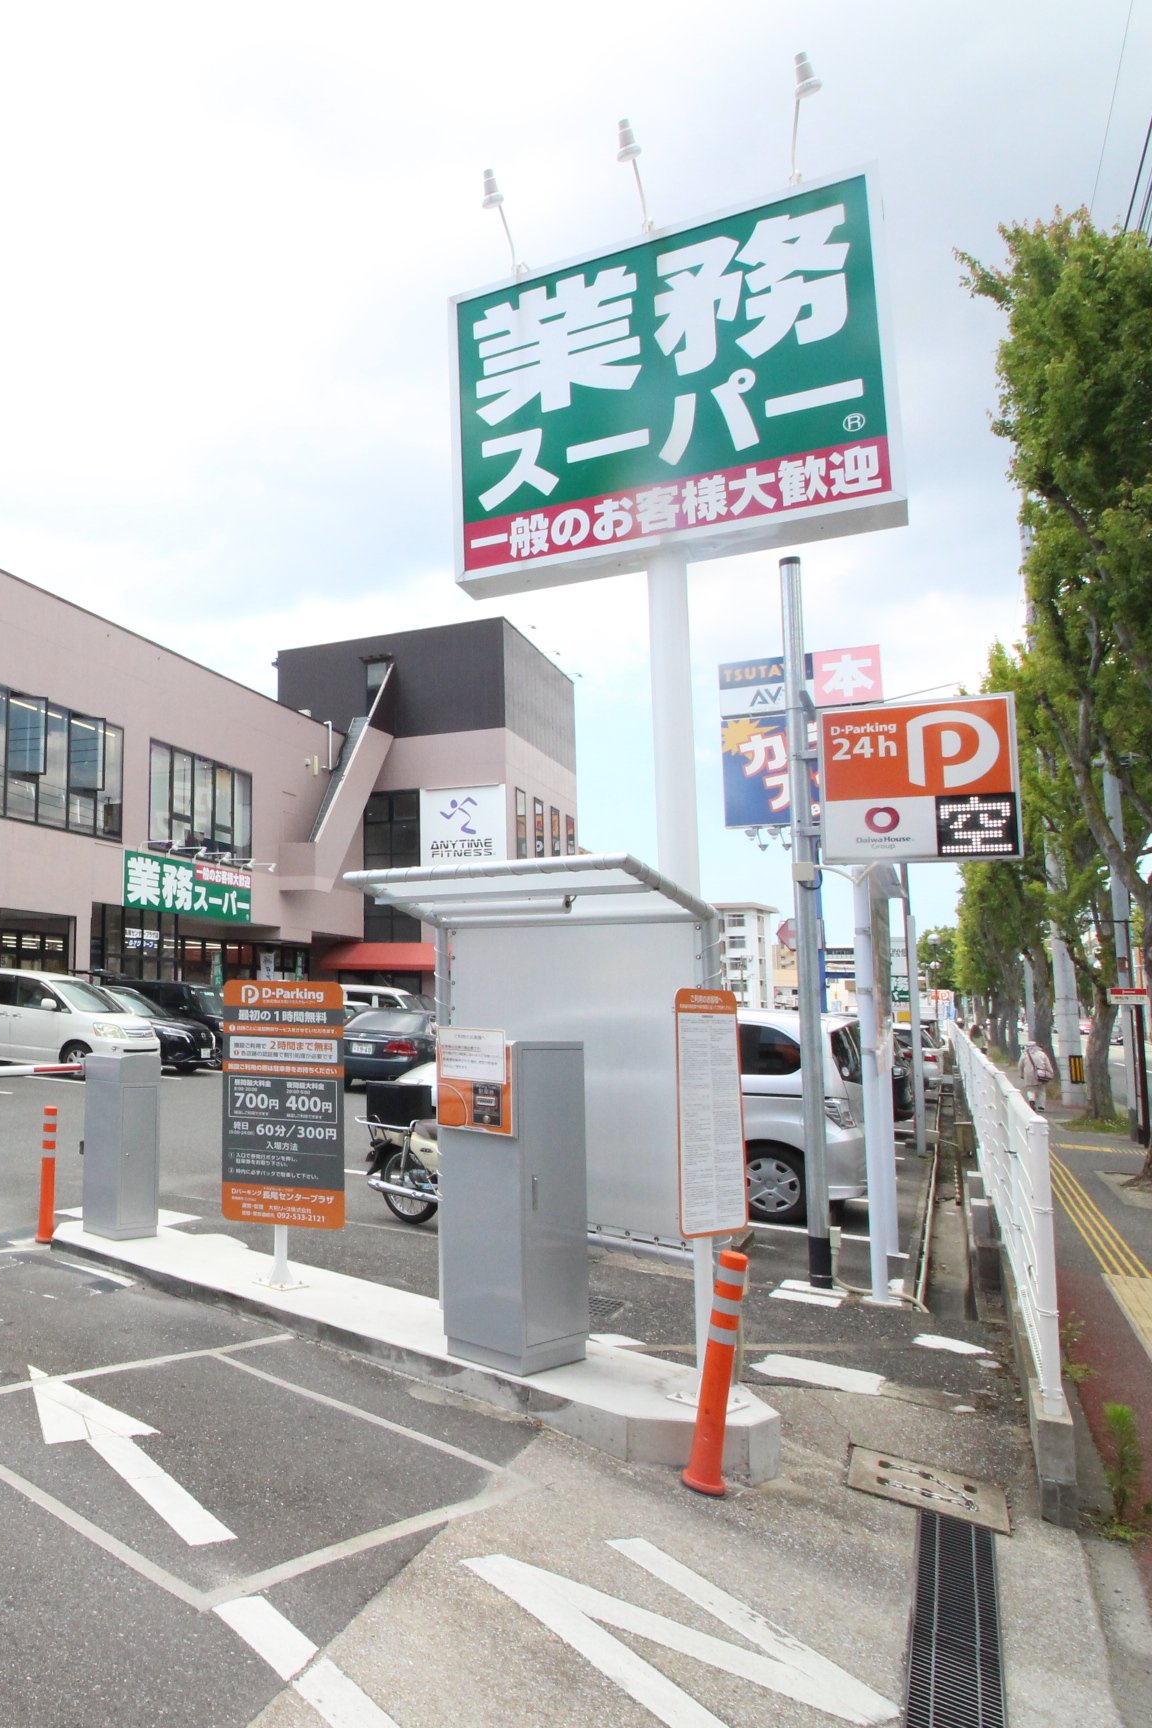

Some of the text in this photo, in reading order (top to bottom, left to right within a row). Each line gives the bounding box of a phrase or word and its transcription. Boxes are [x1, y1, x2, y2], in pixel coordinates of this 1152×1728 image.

[473, 203, 850, 426] 業務
[478, 368, 863, 512] スーパー
[470, 445, 882, 558] 一般のお客様大歓迎
[822, 654, 874, 697] 本
[830, 722, 897, 736] D-Parking
[831, 736, 897, 761] 24h
[940, 796, 1013, 854] 空
[430, 838, 493, 850] ANYTIME
[431, 849, 493, 858] FITNESS
[127, 857, 193, 911] 業務
[194, 885, 250, 915] スーパー
[262, 988, 324, 1002] D-Parking
[234, 1092, 279, 1110] 700円
[285, 1095, 332, 1113] 400円
[233, 1121, 249, 1130] 終日
[266, 1141, 299, 1152] 入場方法
[262, 1190, 335, 1205] 長尾センタープラザ
